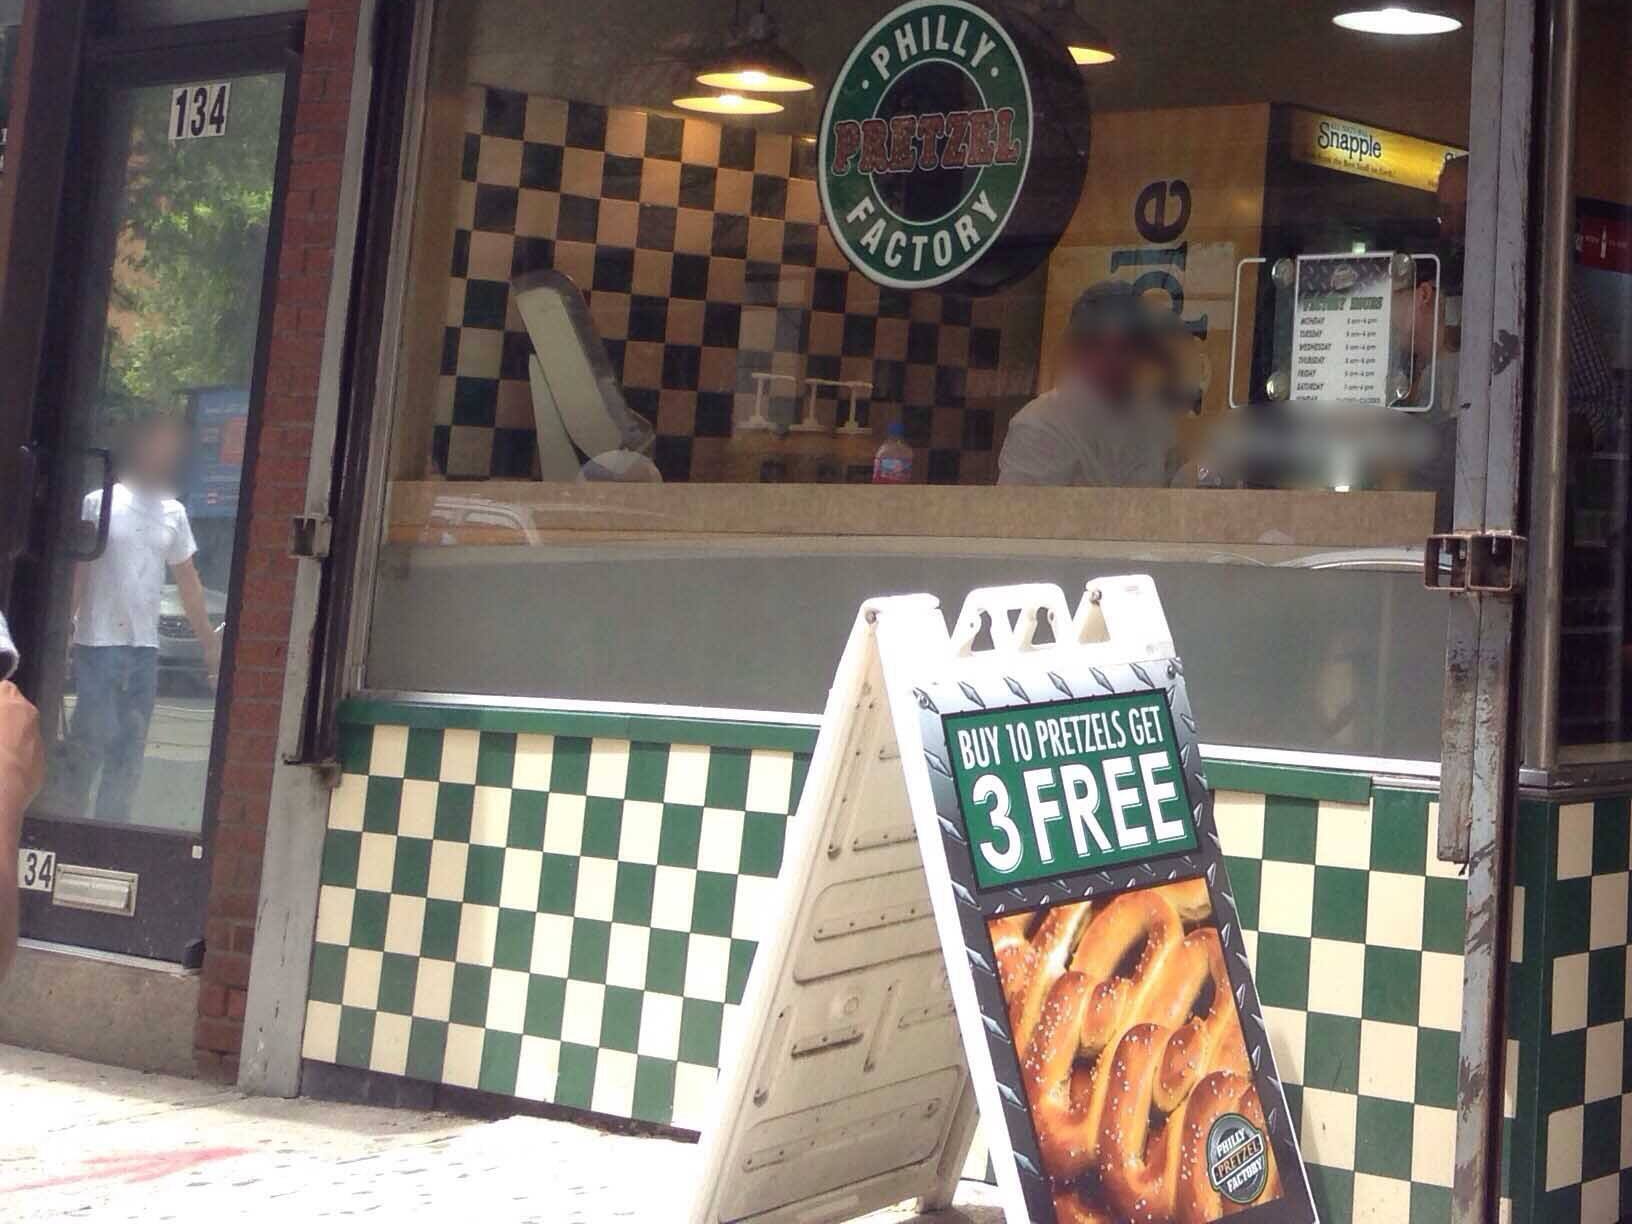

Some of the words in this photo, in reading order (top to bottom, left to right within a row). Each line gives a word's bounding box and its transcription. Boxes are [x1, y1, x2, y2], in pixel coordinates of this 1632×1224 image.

[871, 15, 997, 80] PHILLY
[176, 85, 226, 138] 134
[831, 107, 1021, 175] PRETZEL
[1318, 122, 1382, 161] Snapple
[846, 190, 999, 271] FACTORY
[957, 726, 1001, 770] BUY
[1005, 721, 1033, 762] 10
[1034, 710, 1127, 759] PRETZELS
[1128, 705, 1164, 745] GET
[972, 774, 1024, 874] 3
[1023, 751, 1188, 864] FREE
[1217, 1127, 1246, 1157] PHILLY
[1217, 1140, 1259, 1178] PRETZEL
[1226, 1157, 1263, 1193] FACTORY
